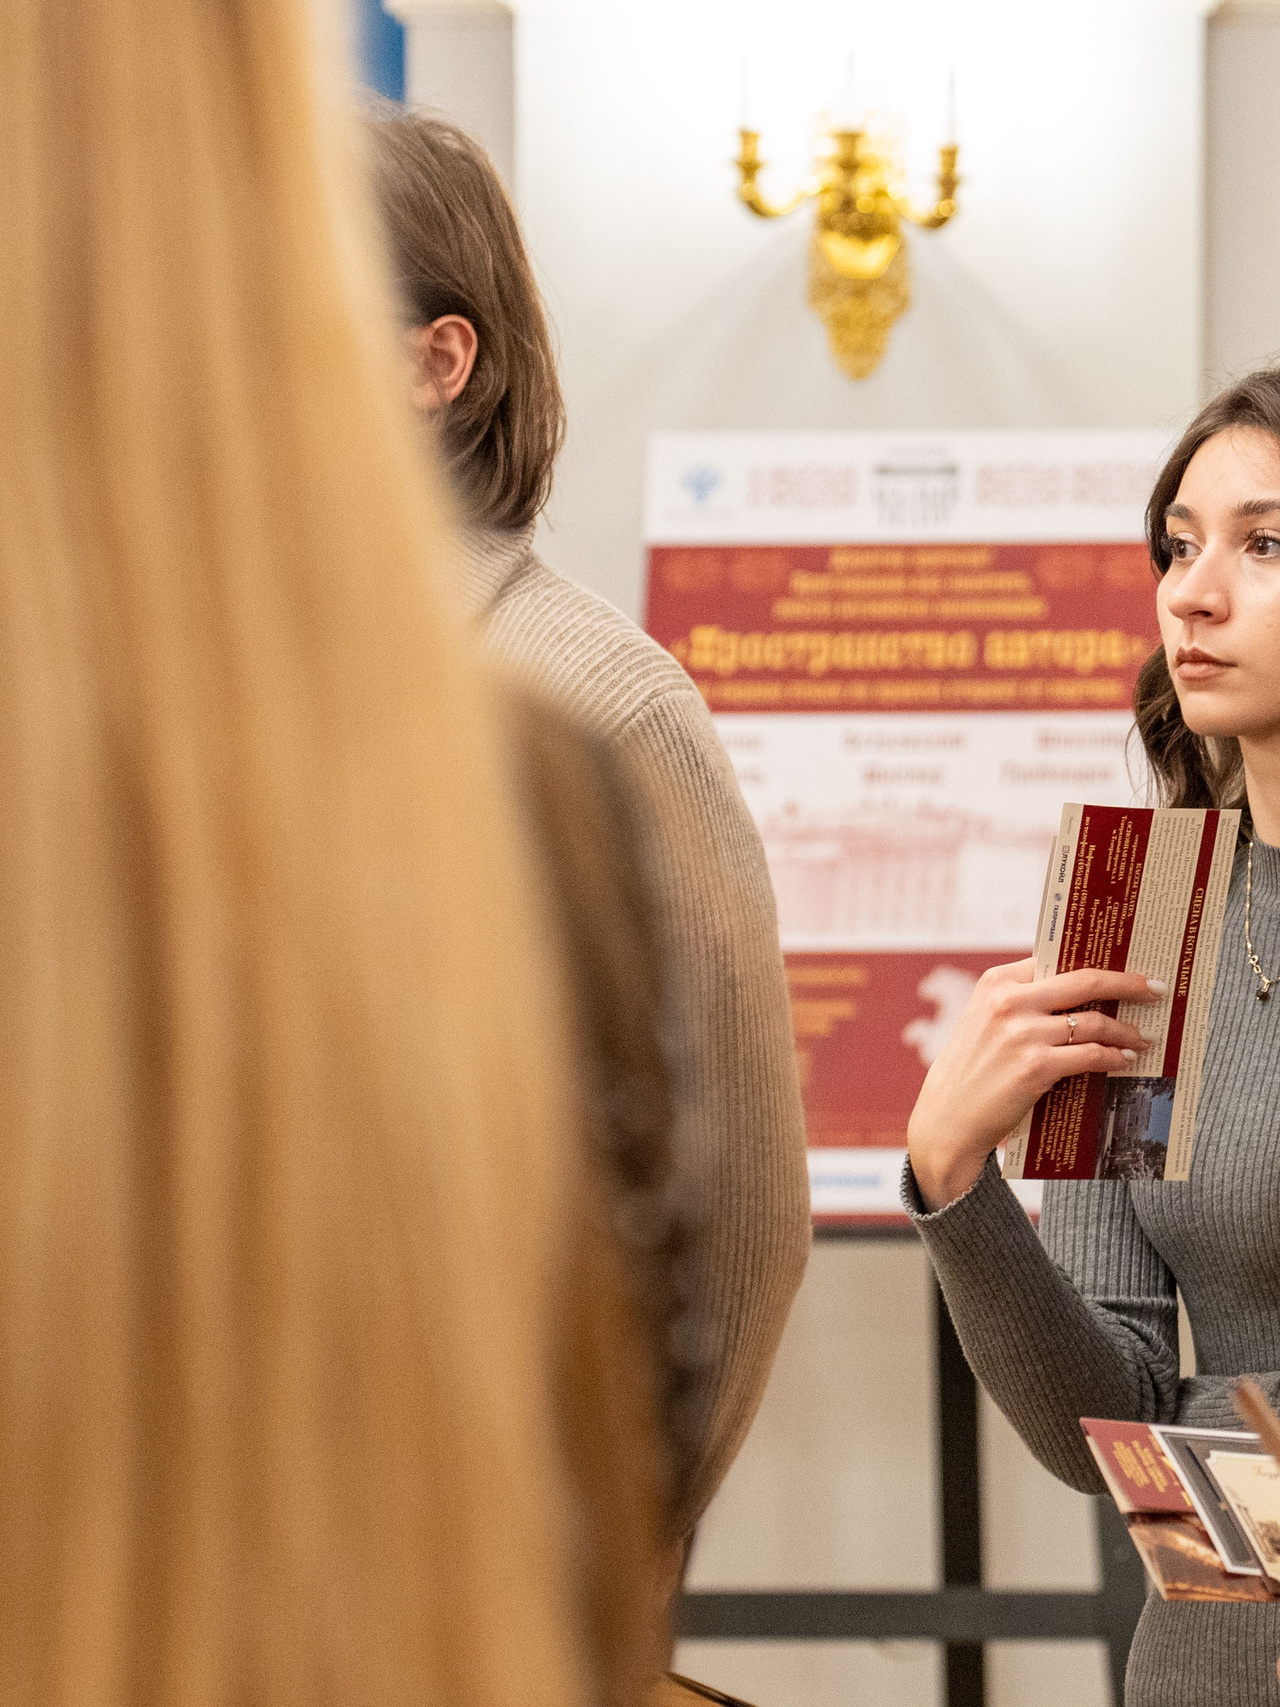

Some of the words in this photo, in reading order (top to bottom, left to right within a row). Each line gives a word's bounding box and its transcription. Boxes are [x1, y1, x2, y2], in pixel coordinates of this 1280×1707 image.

[1083, 816, 1091, 825] по
[1114, 815, 1127, 853] Театральный
[1078, 826, 1090, 857] телефону
[1105, 835, 1116, 871] Театральная
[1121, 820, 1133, 857] ОСНОВНАЯ
[1129, 834, 1139, 862] открыты
[1057, 853, 1069, 882] ЛУКОЙЛ
[1075, 858, 1084, 876] (495)
[1081, 844, 1095, 888] Информация
[1117, 858, 1126, 880] СЦЕНА
[1123, 863, 1134, 896] ежедневно
[1131, 862, 1142, 888] КАССЫ
[1069, 876, 1081, 910] 624-40-46
[1078, 889, 1088, 906] (495)
[1147, 878, 1155, 894] 2019
[1088, 898, 1100, 927] Перерыв
[1109, 901, 1119, 926] СЦЕНА
[1126, 890, 1137, 917] ТЕАТРА
[1189, 887, 1204, 924] СЦЕНА
[1215, 904, 1223, 919] 2012
[1048, 904, 1059, 941] ГАЗПРОМБАНК
[1067, 917, 1075, 925] на
[1072, 907, 1085, 942] 625-48-59,
[1100, 905, 1111, 932] Большая
[1107, 927, 1115, 937] НА
[1118, 919, 1124, 927] до
[1059, 926, 1073, 971] официальном
[1083, 950, 1090, 958] до
[1089, 916, 1103, 964] Добрынинская
[1101, 937, 1113, 969] ОРДЫНК
[1172, 933, 1181, 955] Малого
[1177, 935, 1196, 997] КОГАЛЫМЕ
[1157, 1027, 1165, 1050] декабря
[1049, 1120, 1062, 1160] Пушкинская
[1062, 1090, 1080, 1165] СУМБАТОВА-ЮЖИНА
[1067, 1132, 1080, 1169] КВАРТИРА
